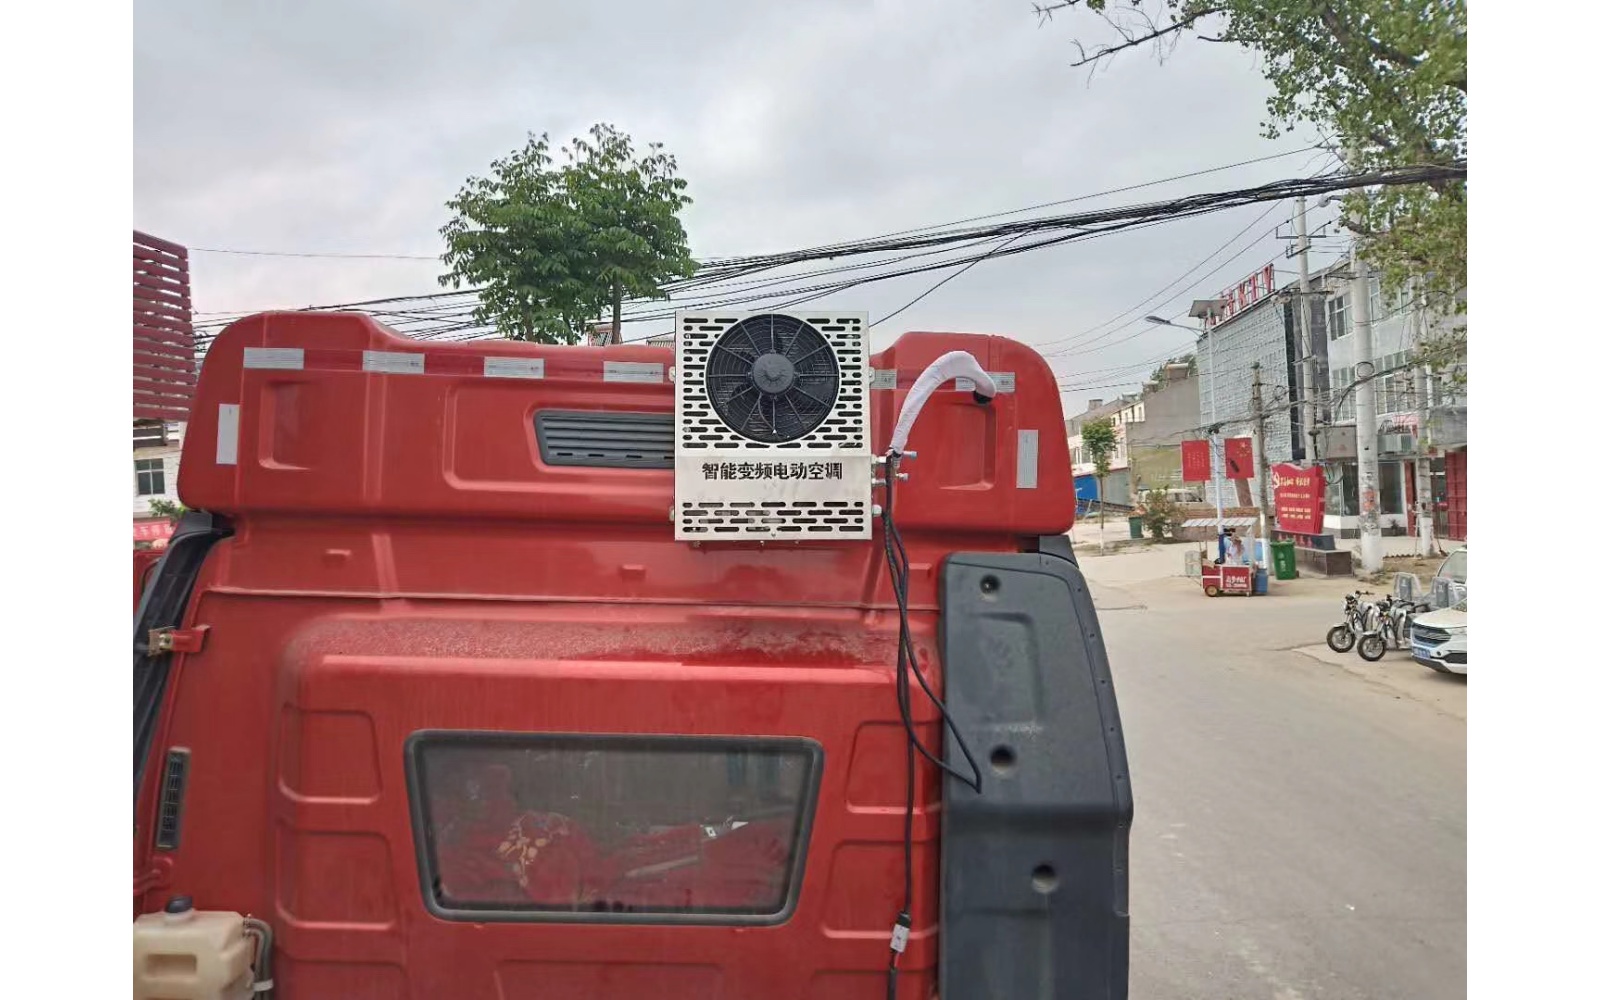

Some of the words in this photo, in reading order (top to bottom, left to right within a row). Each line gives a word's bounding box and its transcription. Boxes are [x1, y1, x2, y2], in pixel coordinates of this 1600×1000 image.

[702, 462, 843, 480] 智能变频电动空调
